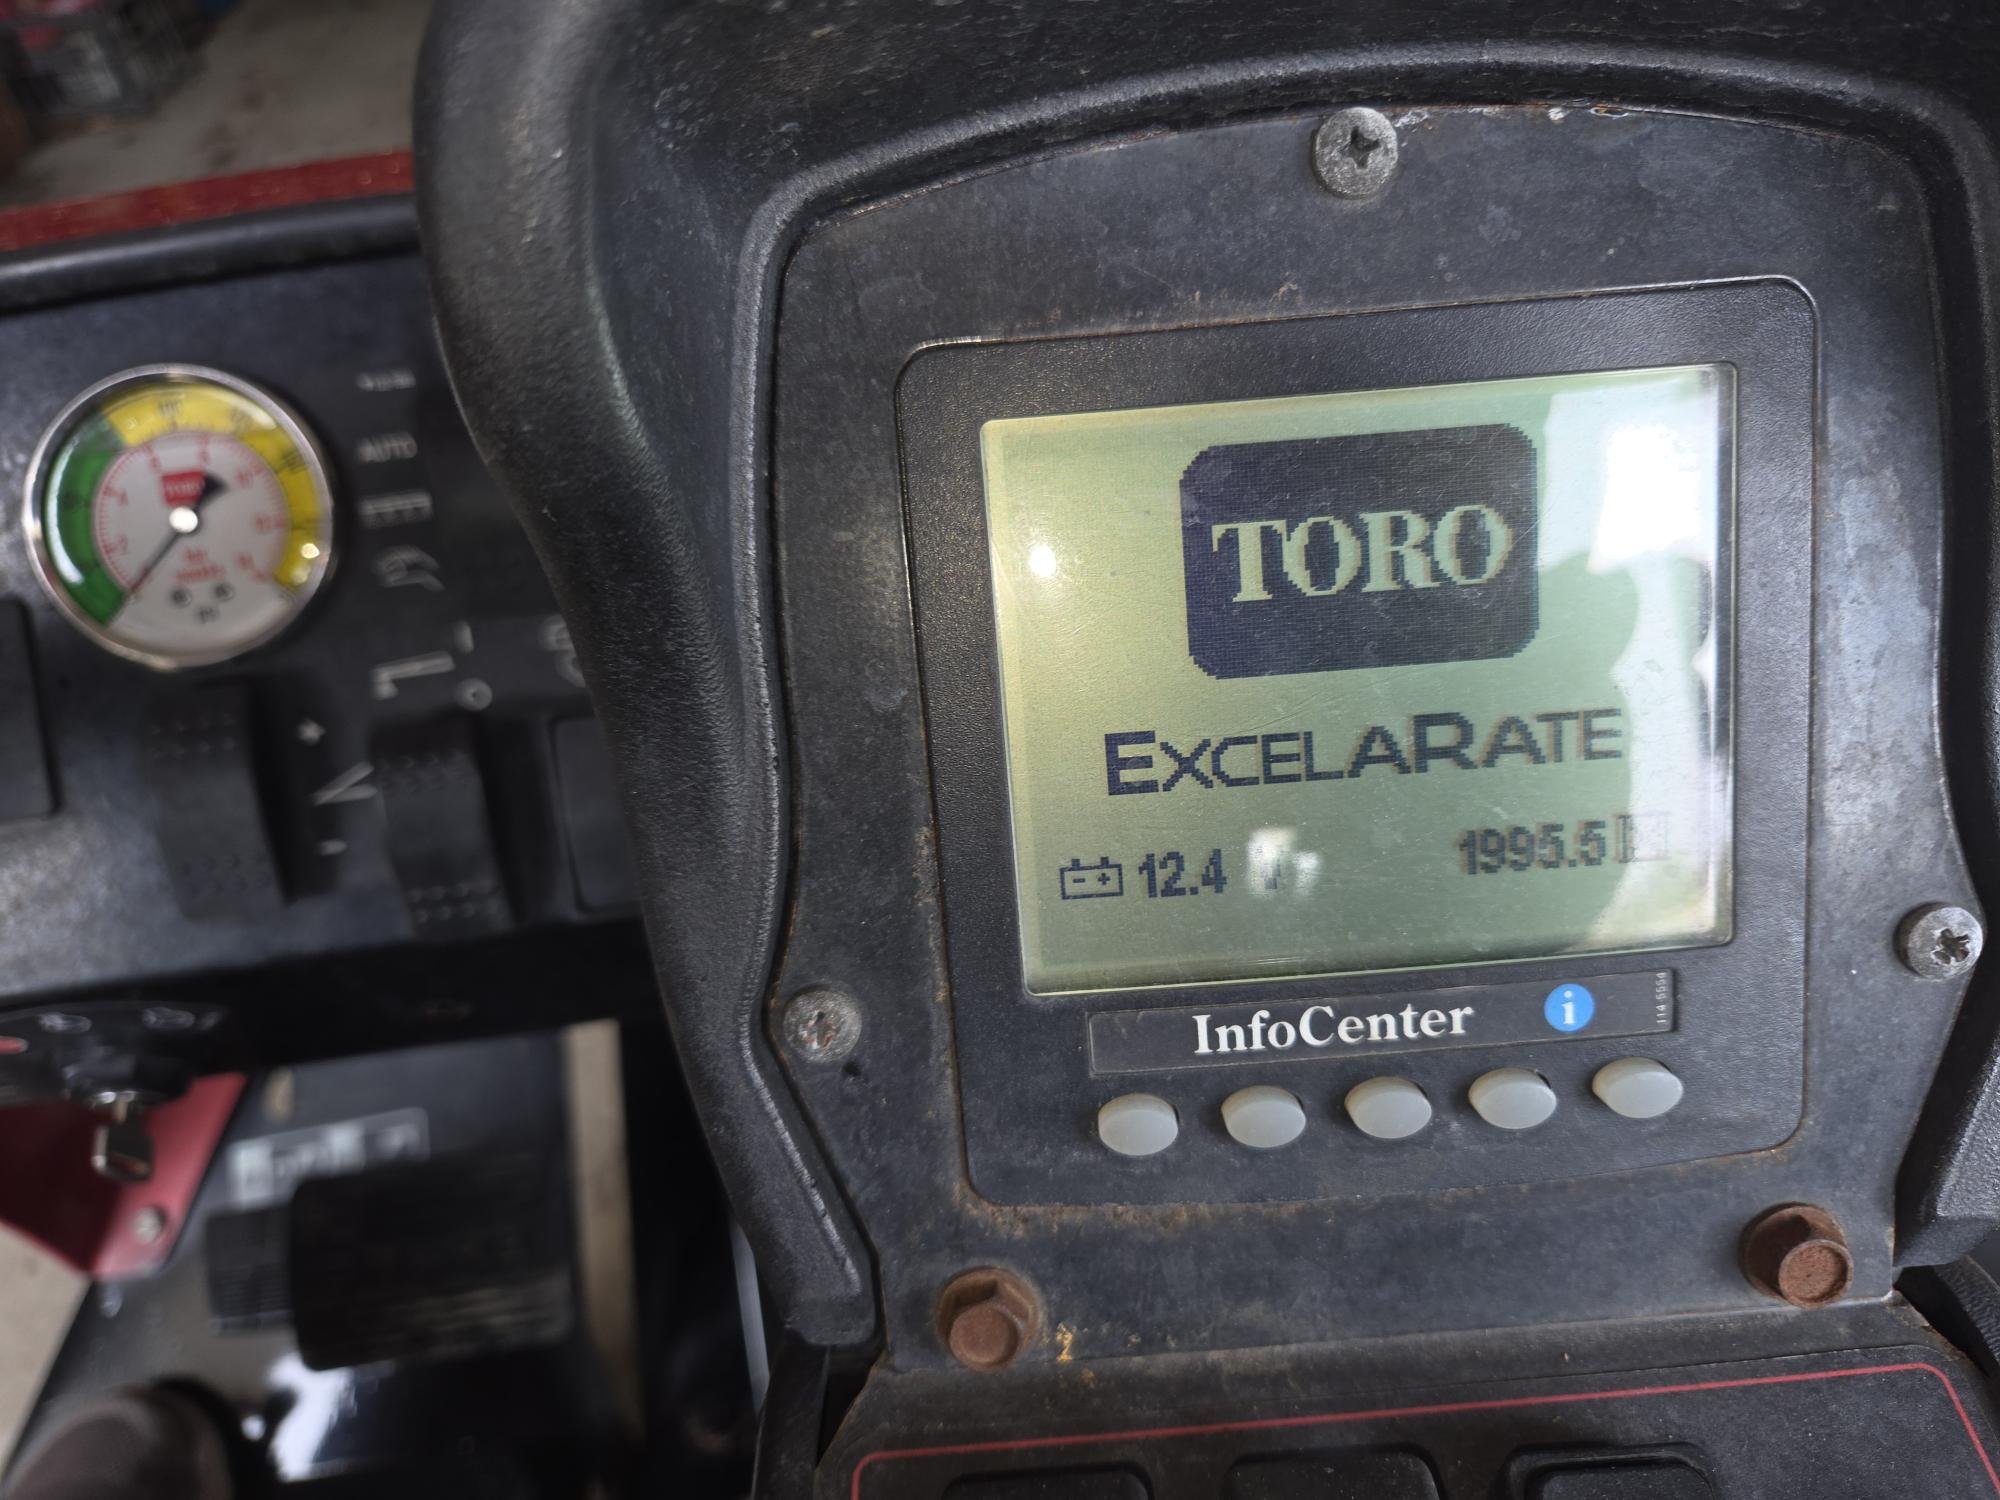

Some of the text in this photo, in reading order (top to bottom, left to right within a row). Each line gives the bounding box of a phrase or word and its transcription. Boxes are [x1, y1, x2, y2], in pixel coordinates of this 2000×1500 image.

[1211, 503, 1517, 604] TORO
[1104, 708, 1624, 797] EXCELARATE
[1138, 848, 1227, 898] 12.4
[1457, 819, 1607, 876] 1995.5
[1192, 990, 1576, 1056] InfoCenter i
